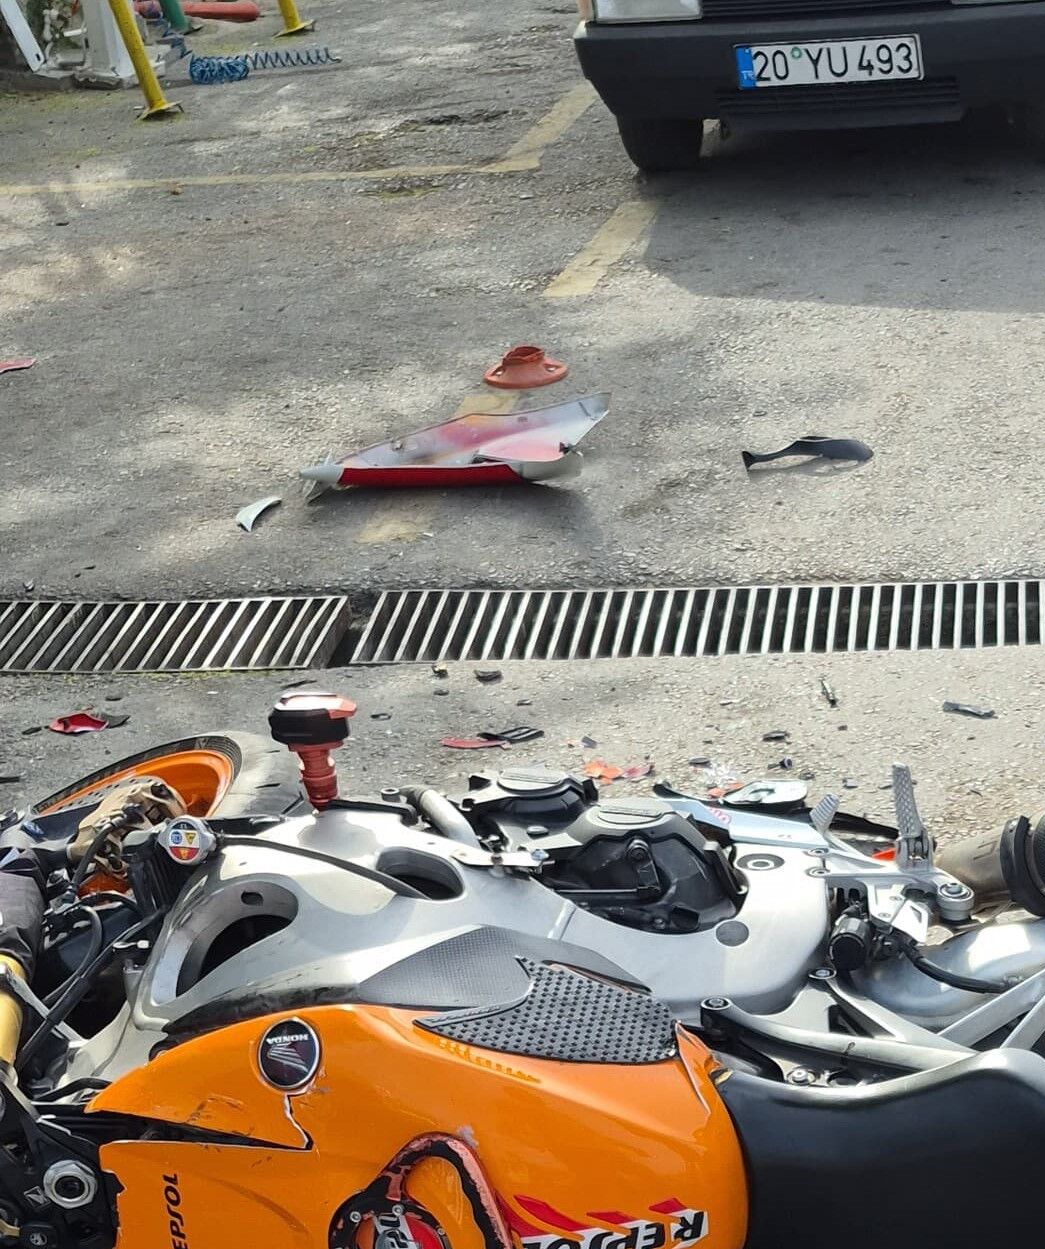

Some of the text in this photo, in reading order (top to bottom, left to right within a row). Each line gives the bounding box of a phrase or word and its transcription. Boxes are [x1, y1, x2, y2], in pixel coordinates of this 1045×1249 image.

[752, 42, 913, 82] 20 YU 493
[266, 1033, 309, 1045] HONDA
